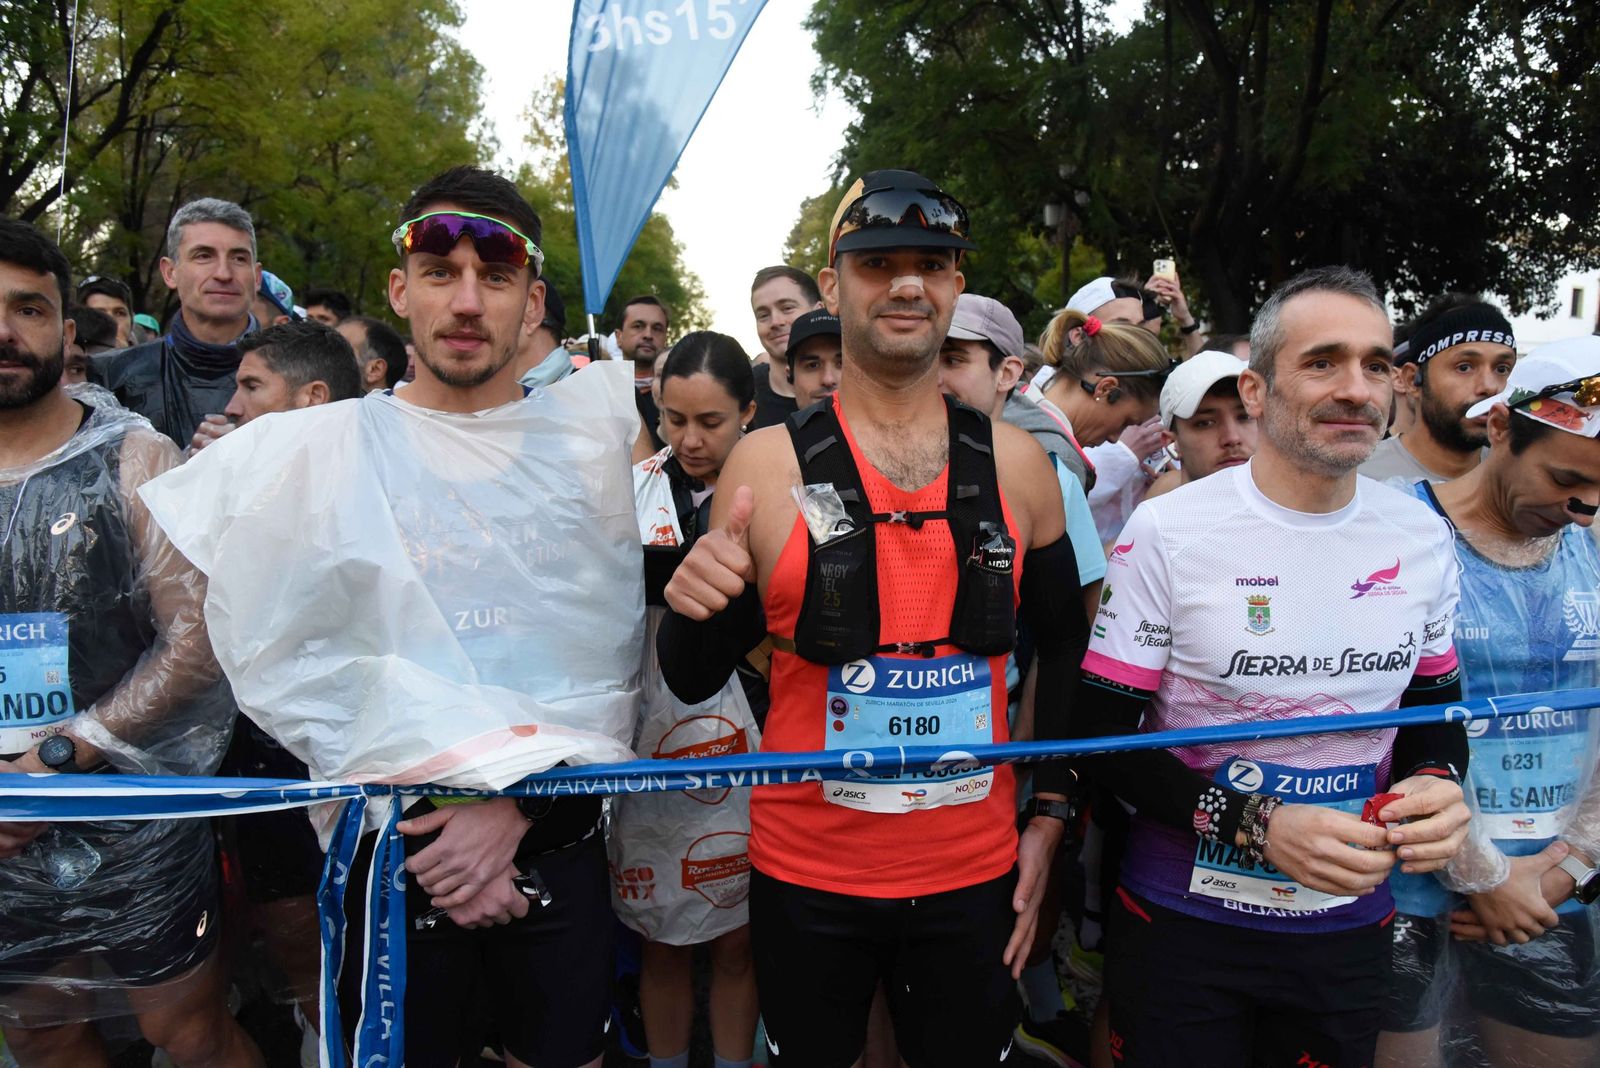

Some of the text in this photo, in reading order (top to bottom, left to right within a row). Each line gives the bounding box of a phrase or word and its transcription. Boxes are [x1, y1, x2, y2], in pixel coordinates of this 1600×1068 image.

[1235, 576, 1279, 587] mobel
[454, 607, 514, 631] ZUR
[1140, 634, 1172, 647] SEGUR
[1219, 648, 1412, 678] SIERRA DE SEGURA
[887, 662, 975, 690] ZURICH
[888, 715, 940, 736] 6180
[1500, 710, 1575, 730] ZURICH
[1501, 752, 1544, 771] 6231
[1274, 772, 1359, 796] ZURICH
[843, 790, 867, 800] asics
[1212, 879, 1237, 889] asics
